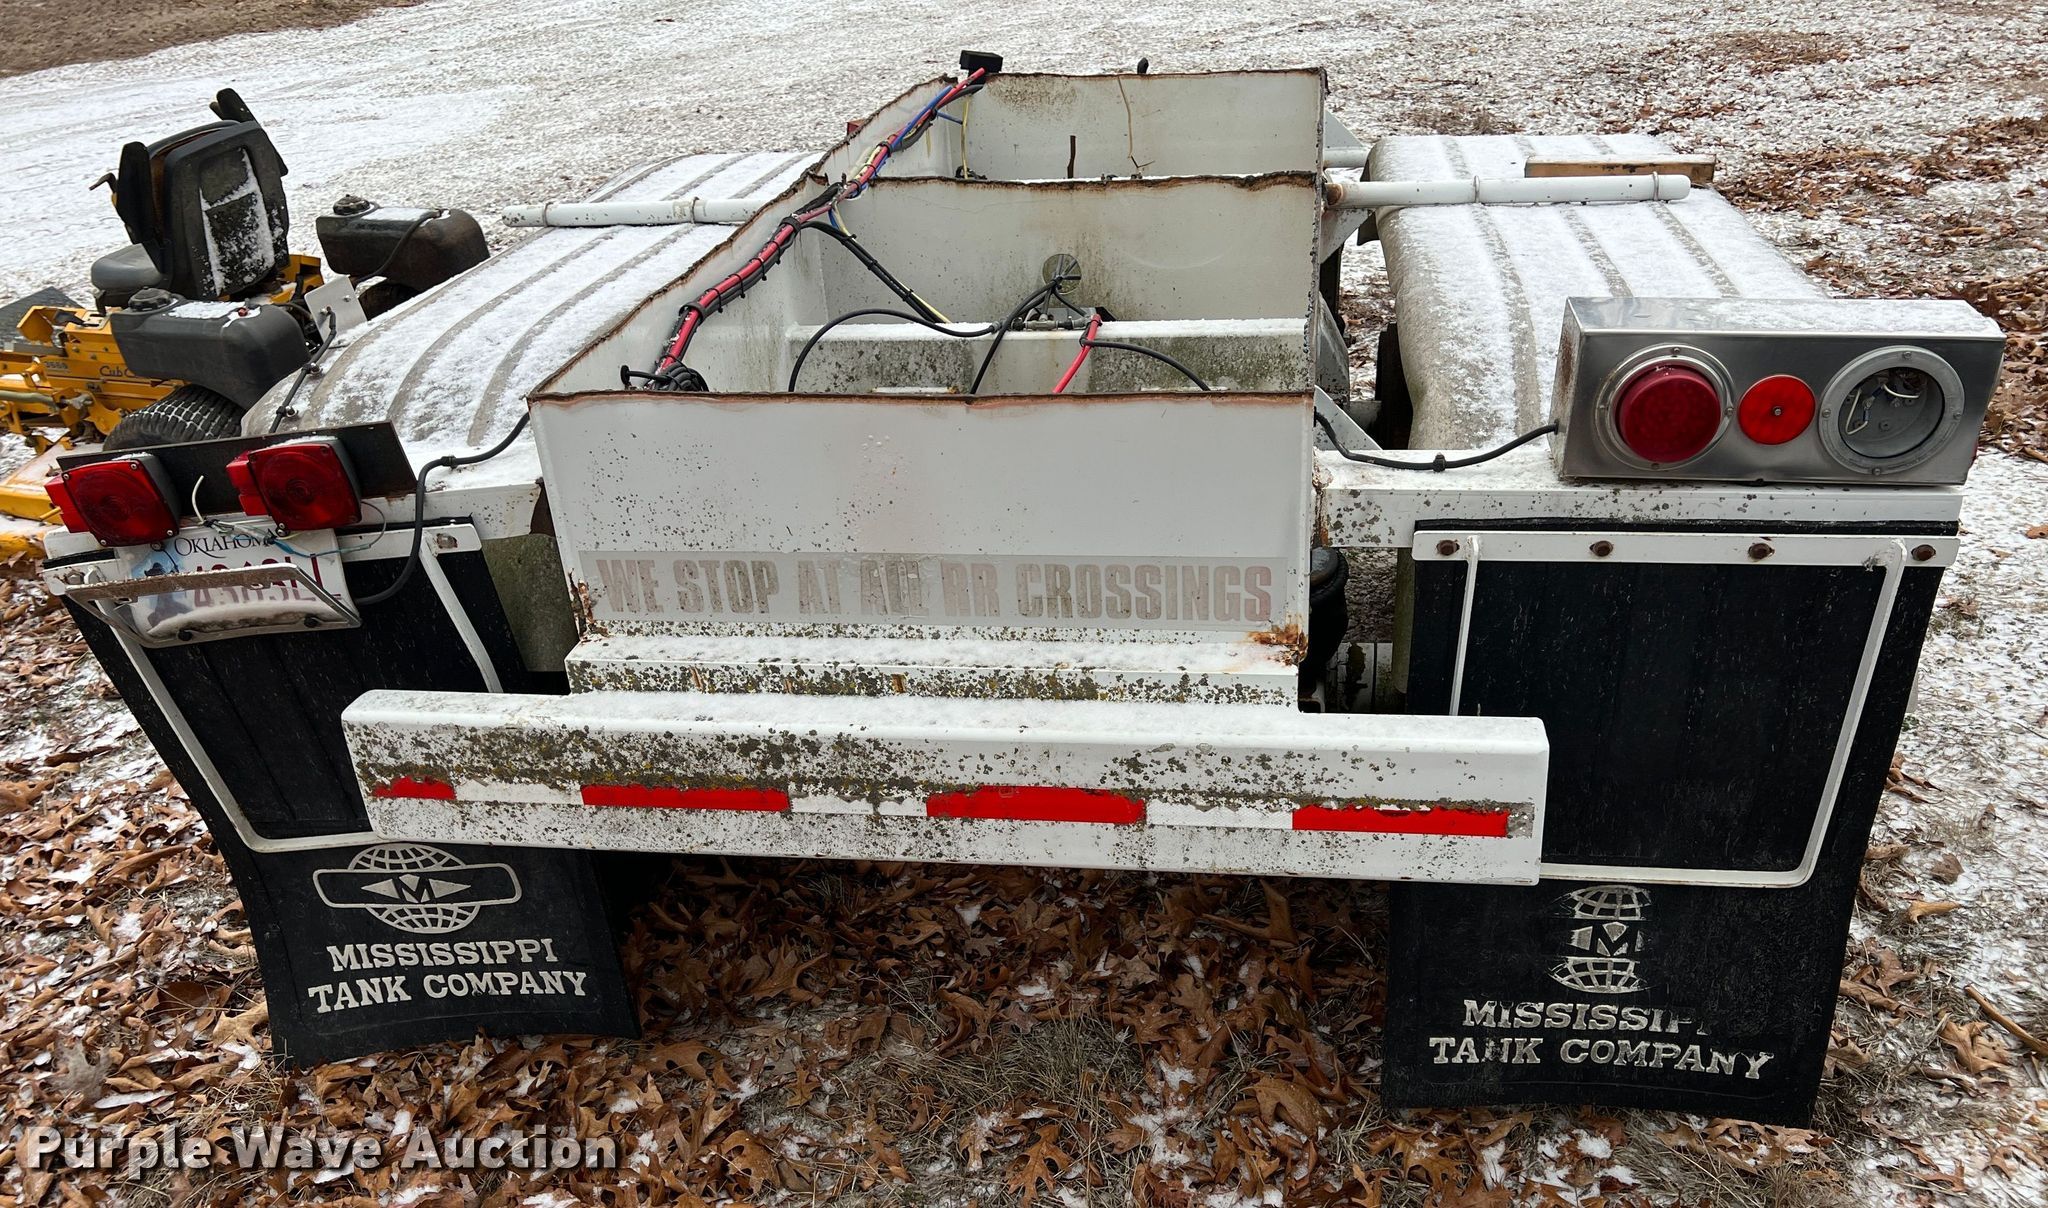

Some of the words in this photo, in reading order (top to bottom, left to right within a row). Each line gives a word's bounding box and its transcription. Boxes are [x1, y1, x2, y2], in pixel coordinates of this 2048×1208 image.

[100, 365, 122, 377] Cub
[596, 559, 664, 614] WE
[673, 559, 780, 614] STOP
[798, 560, 841, 615] AT
[860, 560, 929, 615] ALL
[941, 560, 1000, 617] RR
[1016, 562, 1272, 622] CROSSINGS
[326, 938, 558, 972] MISSISSIPPI
[308, 976, 412, 1014] TANK
[423, 970, 587, 997] COMPANY
[1429, 1037, 1544, 1064] TANK
[1560, 1038, 1774, 1079] COMPANY
